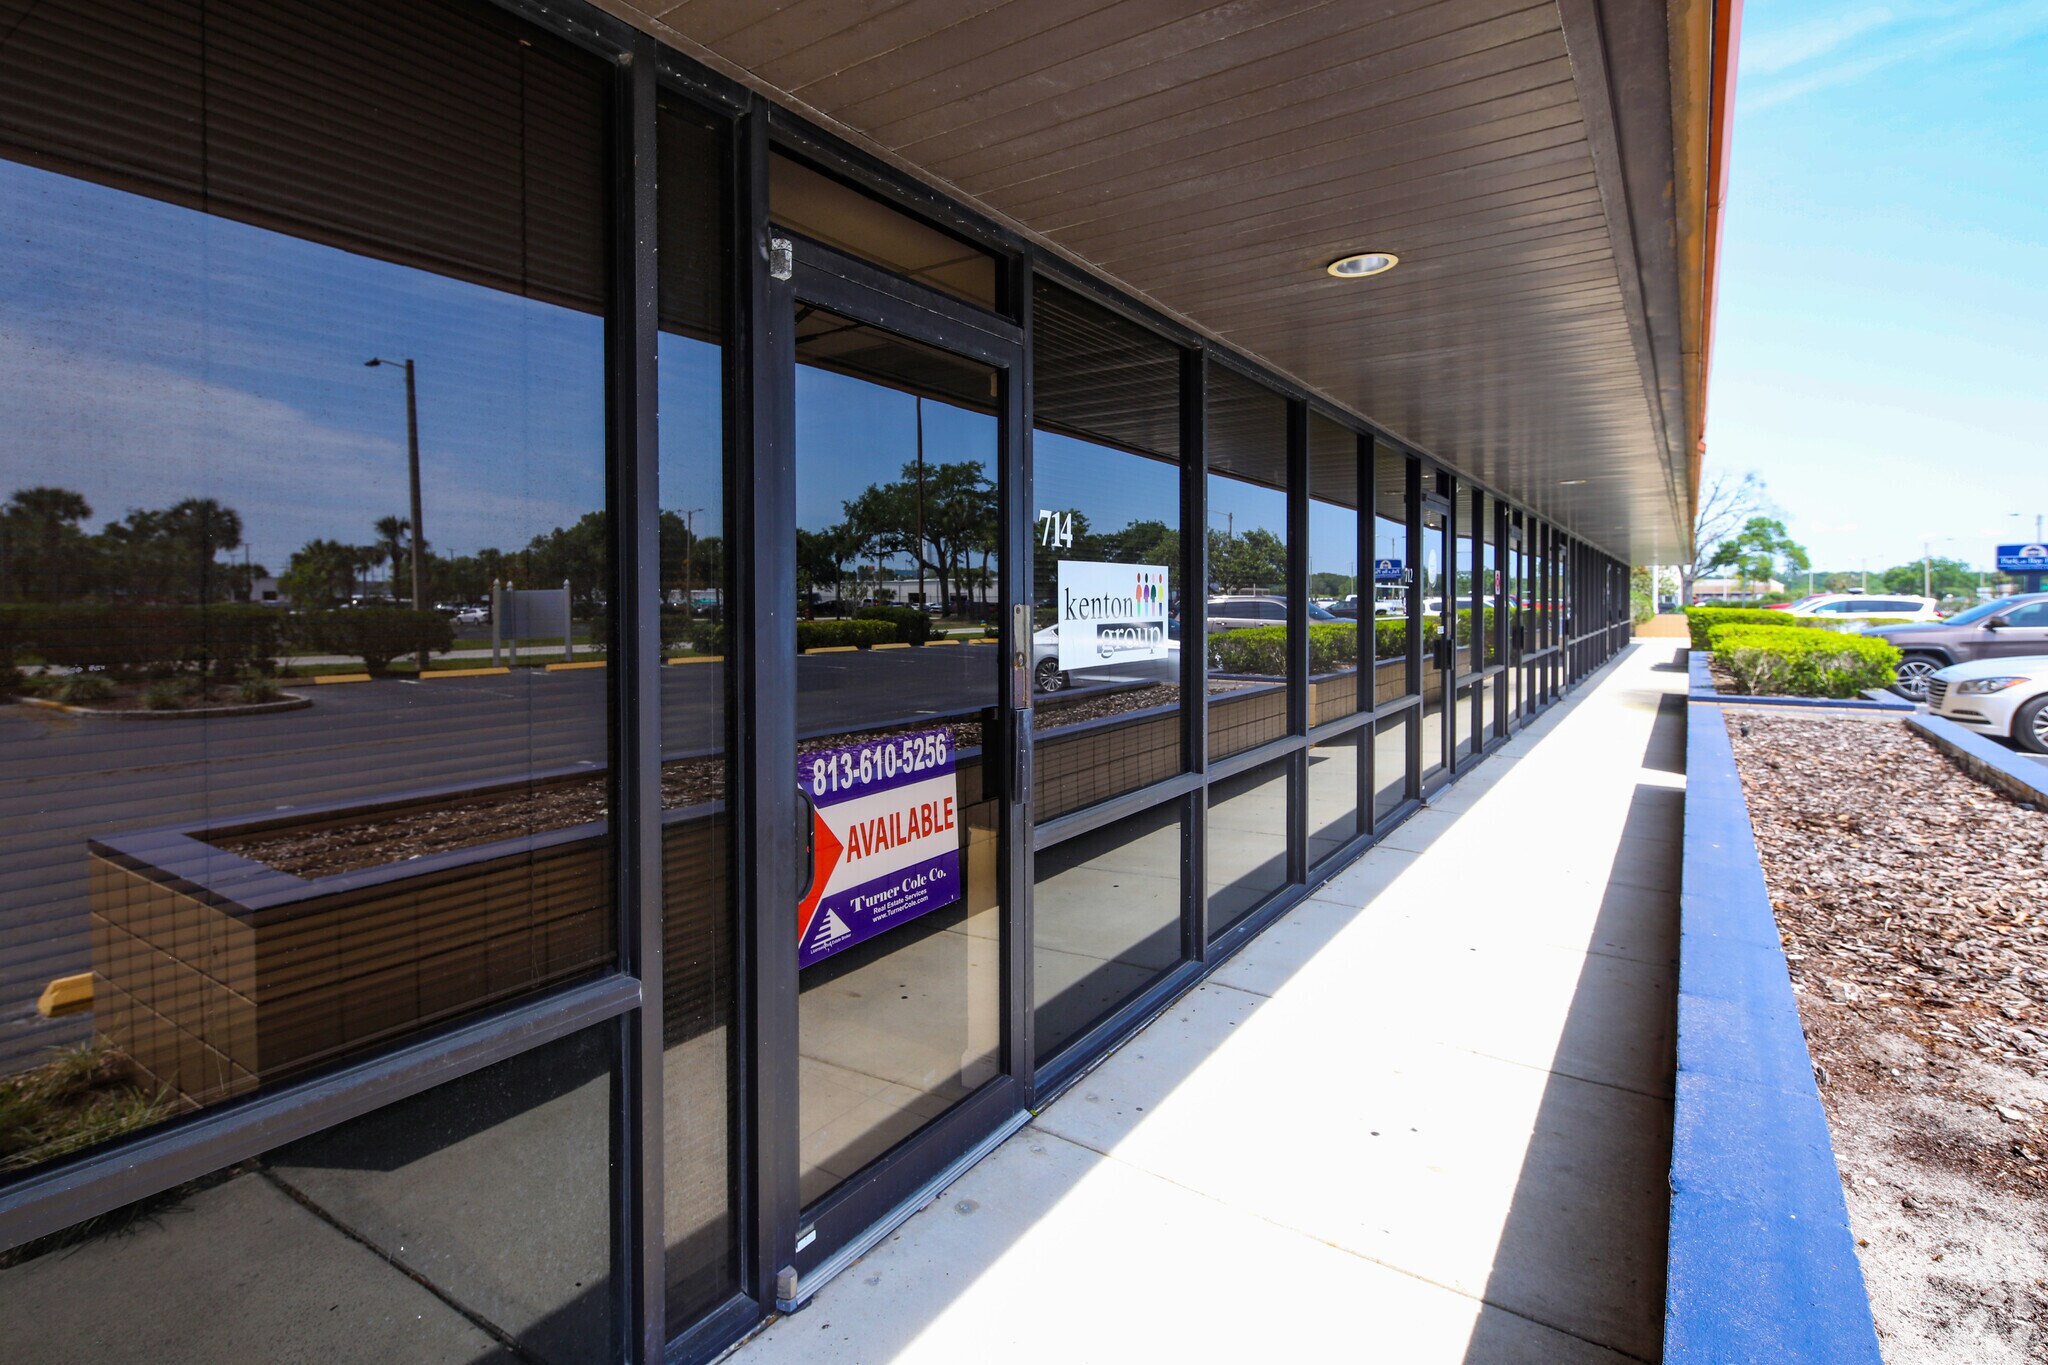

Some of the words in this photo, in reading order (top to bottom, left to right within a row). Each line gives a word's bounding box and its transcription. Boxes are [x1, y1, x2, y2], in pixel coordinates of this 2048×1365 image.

[1038, 509, 1073, 548] 714
[1405, 567, 1413, 583] 712
[1064, 587, 1133, 620] kenton
[1100, 625, 1161, 658] group
[813, 733, 947, 796] 813-610-5256
[846, 796, 954, 864] AVAILABLE
[850, 886, 900, 913] Turner
[902, 874, 927, 892] Cole
[929, 868, 947, 881] Co.
[873, 903, 886, 915] Real
[887, 898, 904, 909] Estate
[905, 889, 927, 901] Services
[872, 895, 928, 922] www.TurnerCole.com
